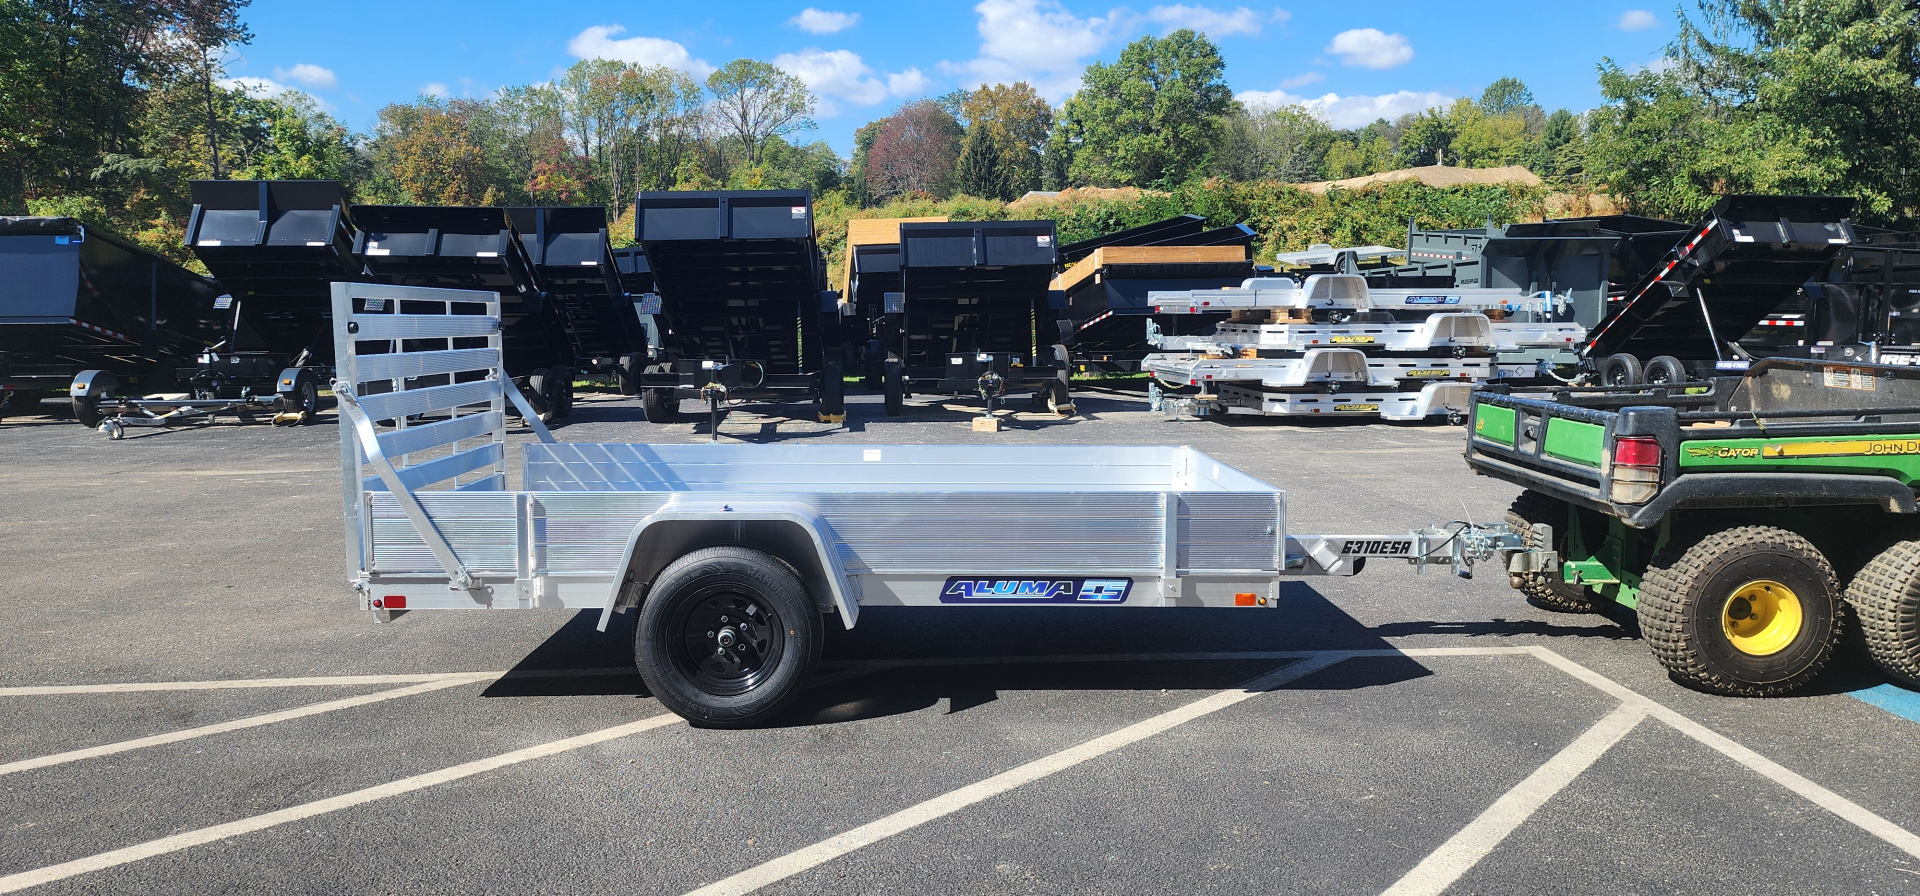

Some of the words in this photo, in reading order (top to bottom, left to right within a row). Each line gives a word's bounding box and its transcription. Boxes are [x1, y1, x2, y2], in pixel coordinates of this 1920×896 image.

[1718, 447, 1760, 459] GATOR
[1864, 442, 1903, 453] JOHN
[1906, 441, 1920, 452] D
[1341, 540, 1413, 555] 6310ESA
[945, 580, 1074, 599] ALUMA
